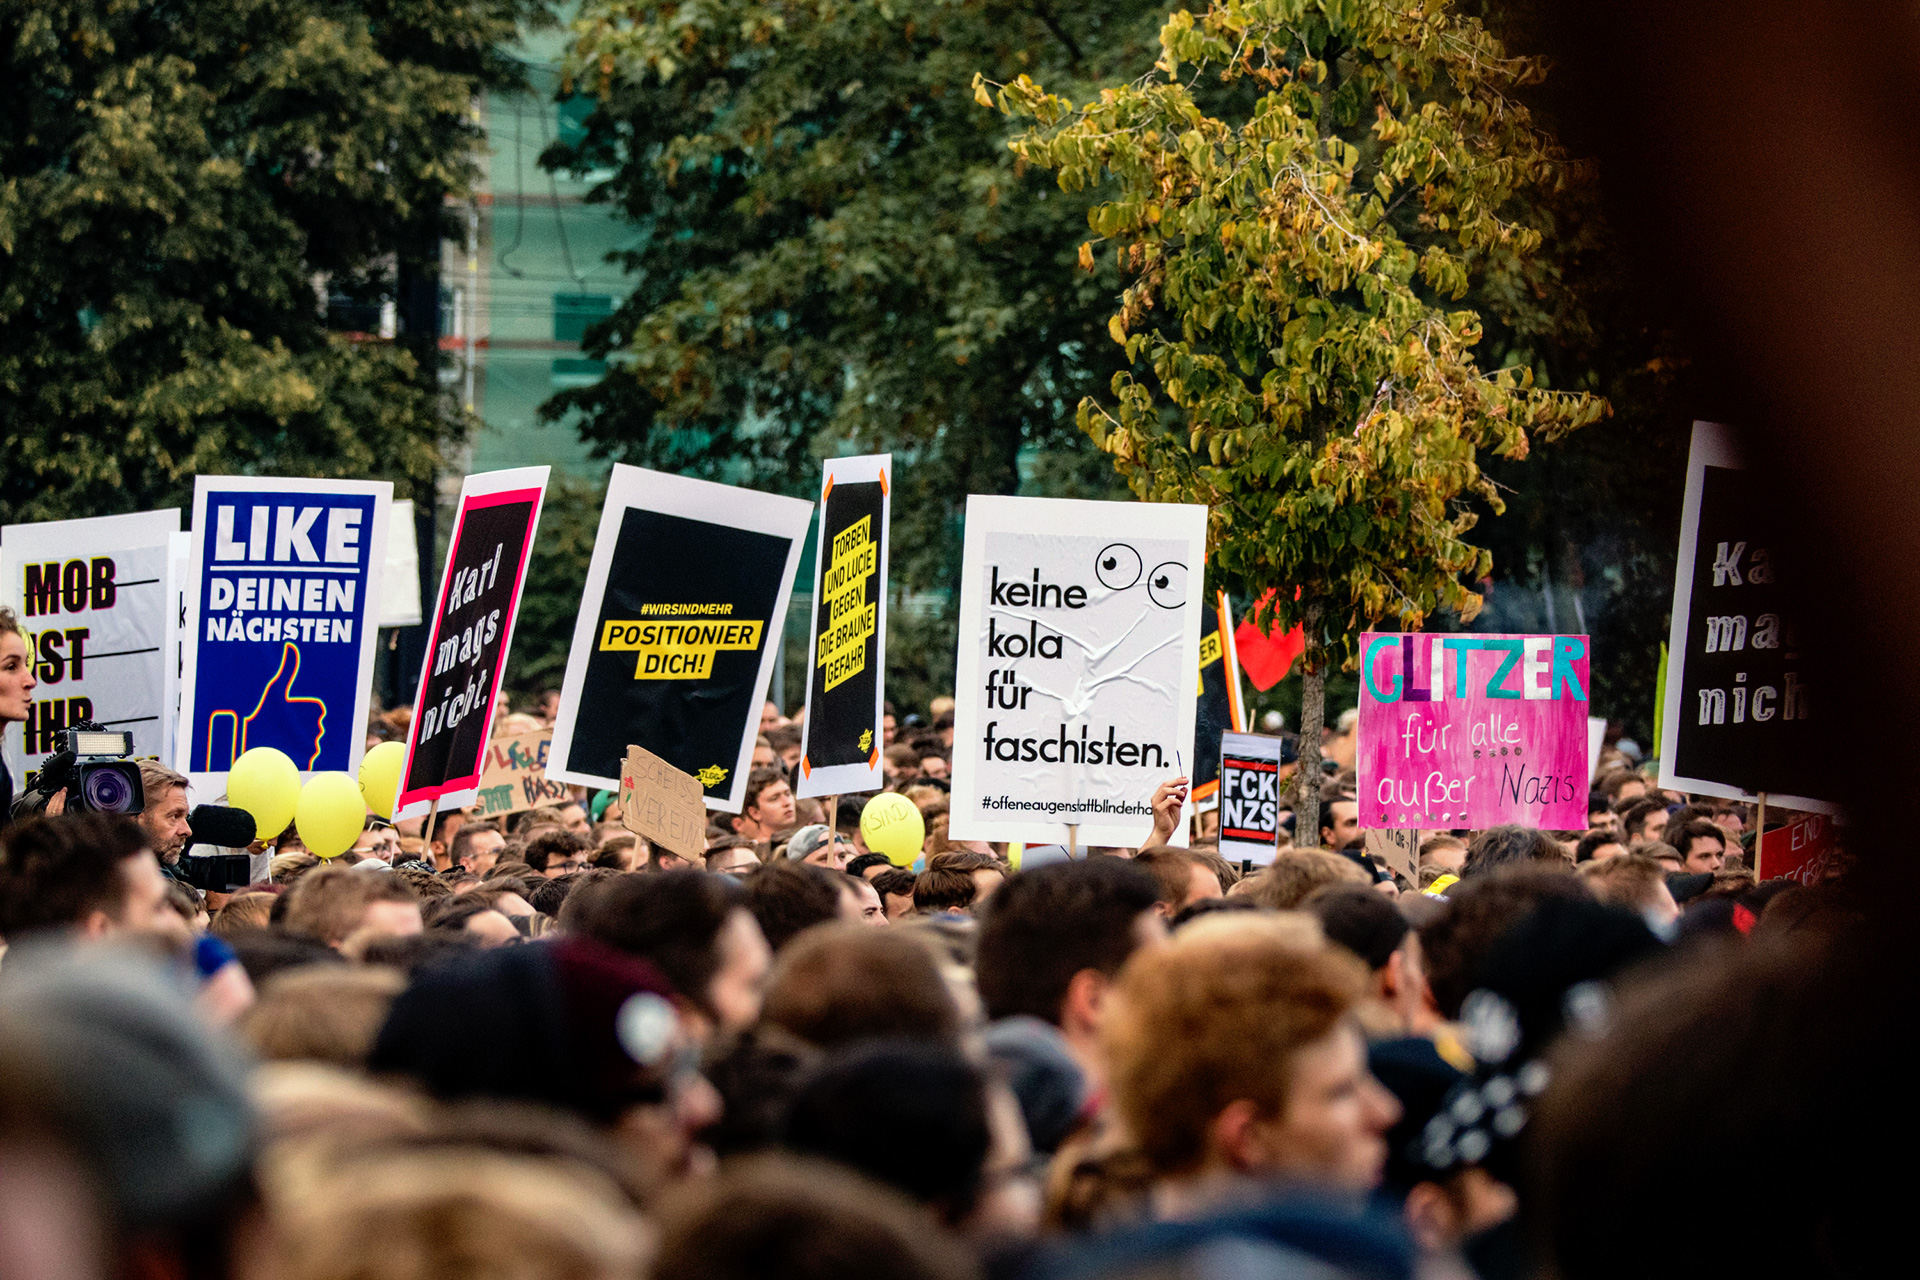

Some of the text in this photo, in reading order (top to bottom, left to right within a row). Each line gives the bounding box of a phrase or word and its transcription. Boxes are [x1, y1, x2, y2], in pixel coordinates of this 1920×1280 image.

[214, 505, 363, 564] LIKE
[834, 521, 868, 560] TORBEN
[24, 555, 117, 617] MOB
[448, 542, 504, 615] Karl
[827, 548, 873, 595] UND LUCIE
[1712, 541, 1776, 587] Ka
[208, 577, 357, 613] DEINEN
[640, 603, 734, 616] #WIRSINDMEHR
[832, 583, 863, 621] GEGEN
[989, 565, 1088, 610] keine
[206, 609, 354, 643] NÄCHSTEN
[434, 608, 501, 677] mags
[607, 625, 755, 646] POSITIONIER
[820, 608, 873, 660] DIE BRAUNE
[987, 617, 1063, 660] kola
[643, 653, 707, 674] DICH!
[826, 643, 864, 684] GEFAHR
[1363, 635, 1588, 704] GLITZER
[420, 668, 488, 745] nicht.
[985, 669, 1033, 711] für
[1698, 671, 1809, 726] nich
[983, 720, 1170, 769] faschisten.
[1401, 712, 1521, 758] für alle
[635, 756, 695, 806] SCHEISS
[1224, 768, 1277, 802] FCK
[1377, 761, 1576, 816] außer Nazis
[635, 792, 701, 848] VEREIN
[1223, 799, 1277, 831] NZS
